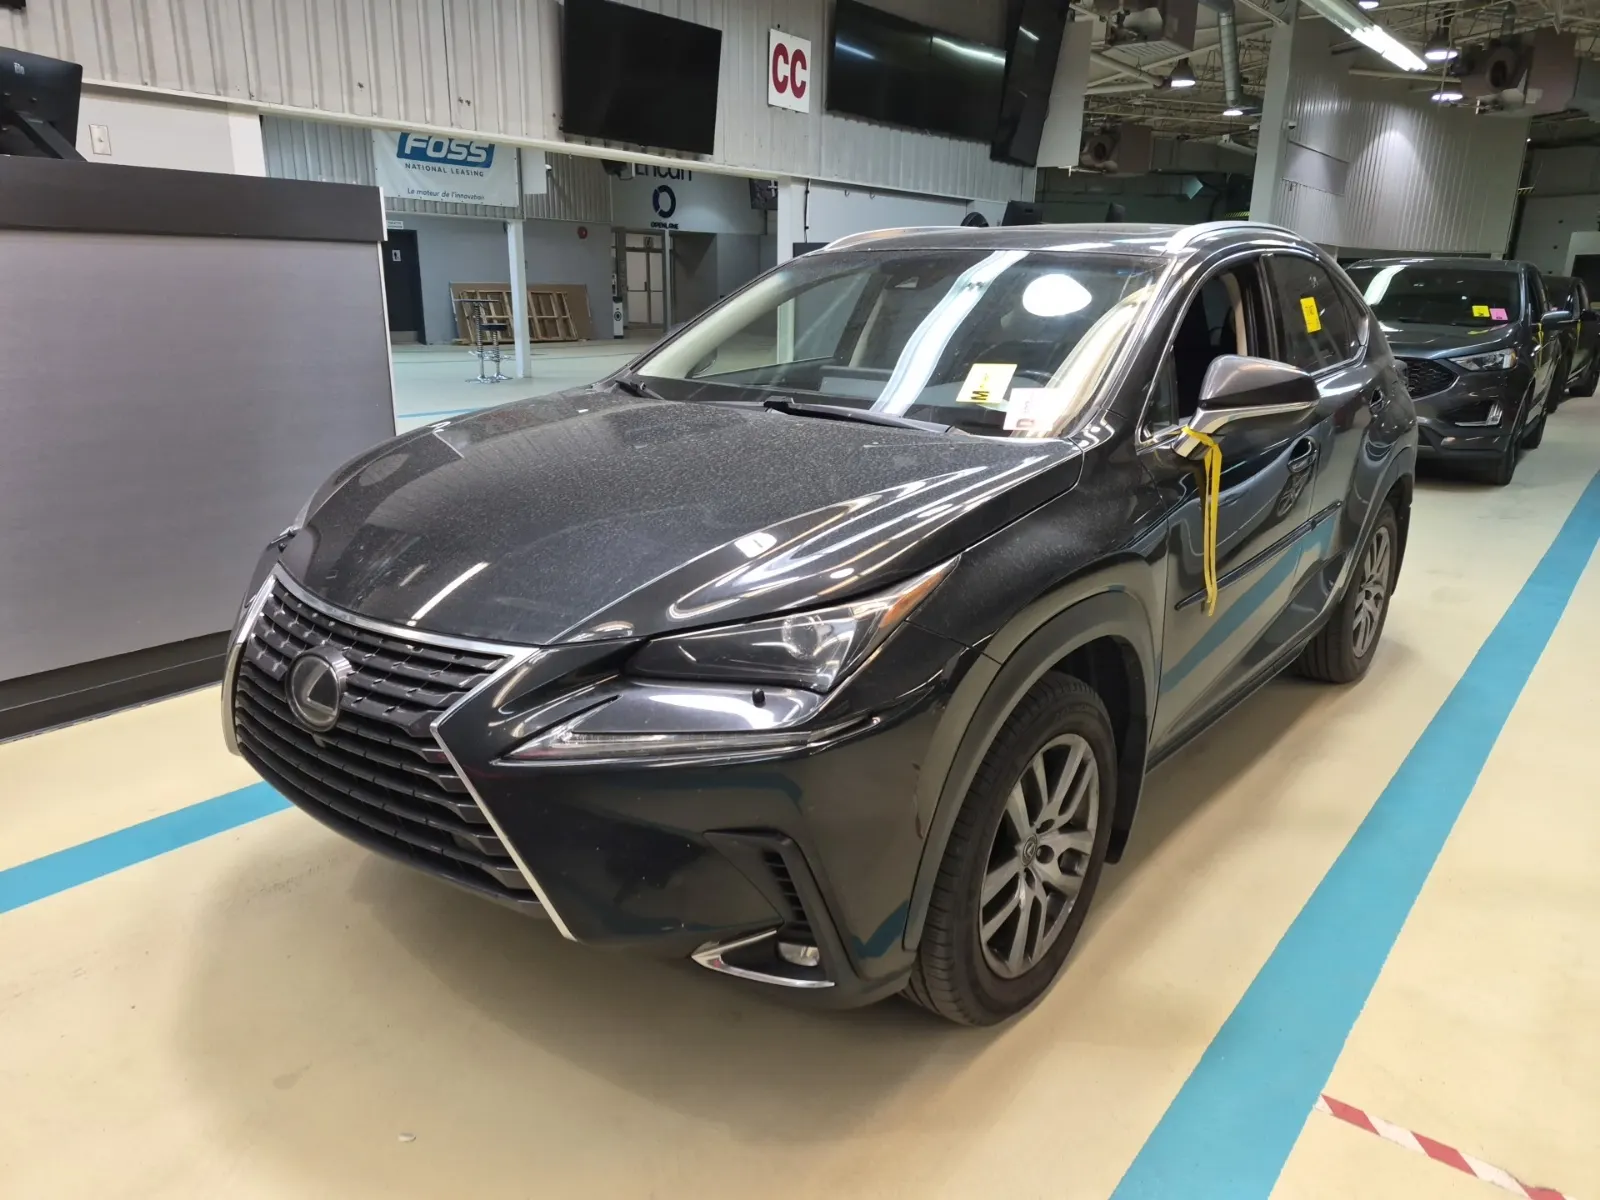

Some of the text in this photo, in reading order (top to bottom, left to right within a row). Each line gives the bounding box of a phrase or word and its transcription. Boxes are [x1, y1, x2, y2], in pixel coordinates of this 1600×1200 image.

[772, 43, 807, 99] CC
[404, 132, 487, 163] FOSS
[405, 163, 484, 177] NATIONAL LEASING
[441, 190, 450, 198] de
